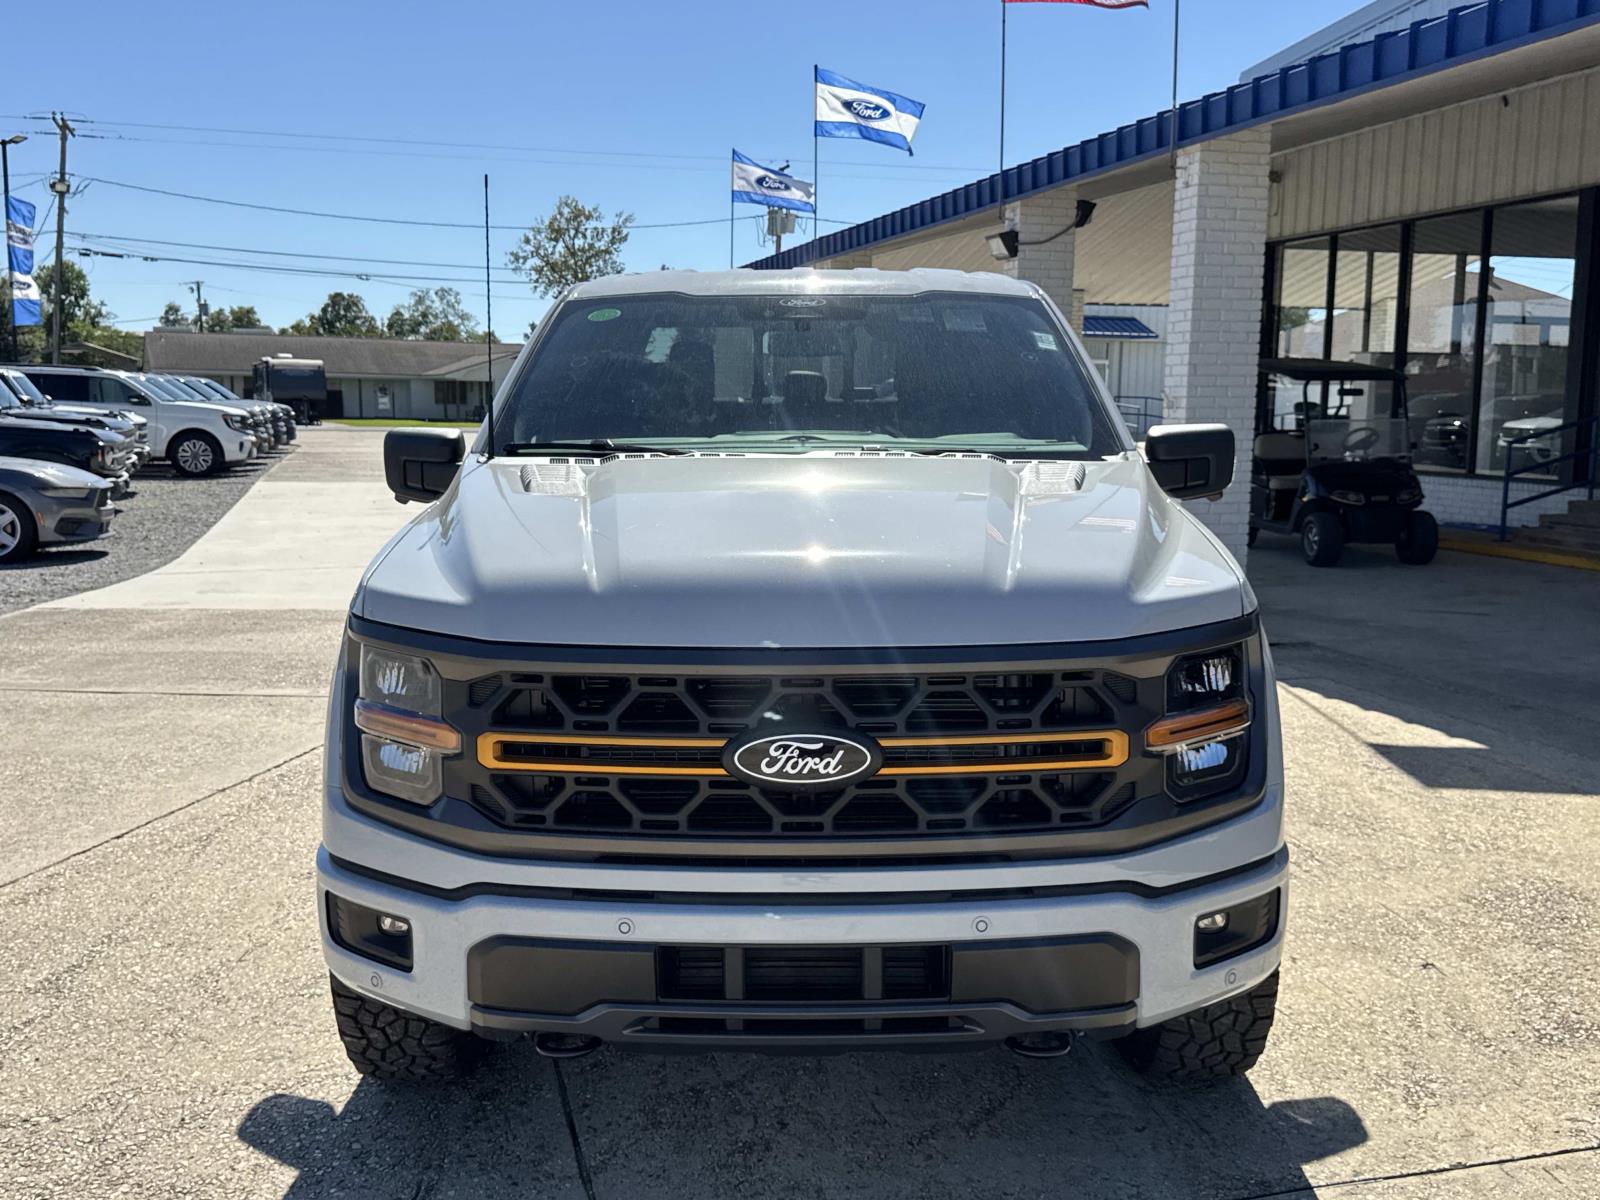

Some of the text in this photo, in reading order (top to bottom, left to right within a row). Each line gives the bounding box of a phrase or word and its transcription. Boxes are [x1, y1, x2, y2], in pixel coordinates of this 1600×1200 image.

[850, 101, 882, 119] Ford
[762, 175, 786, 190] Ford
[760, 741, 845, 775] Ford
